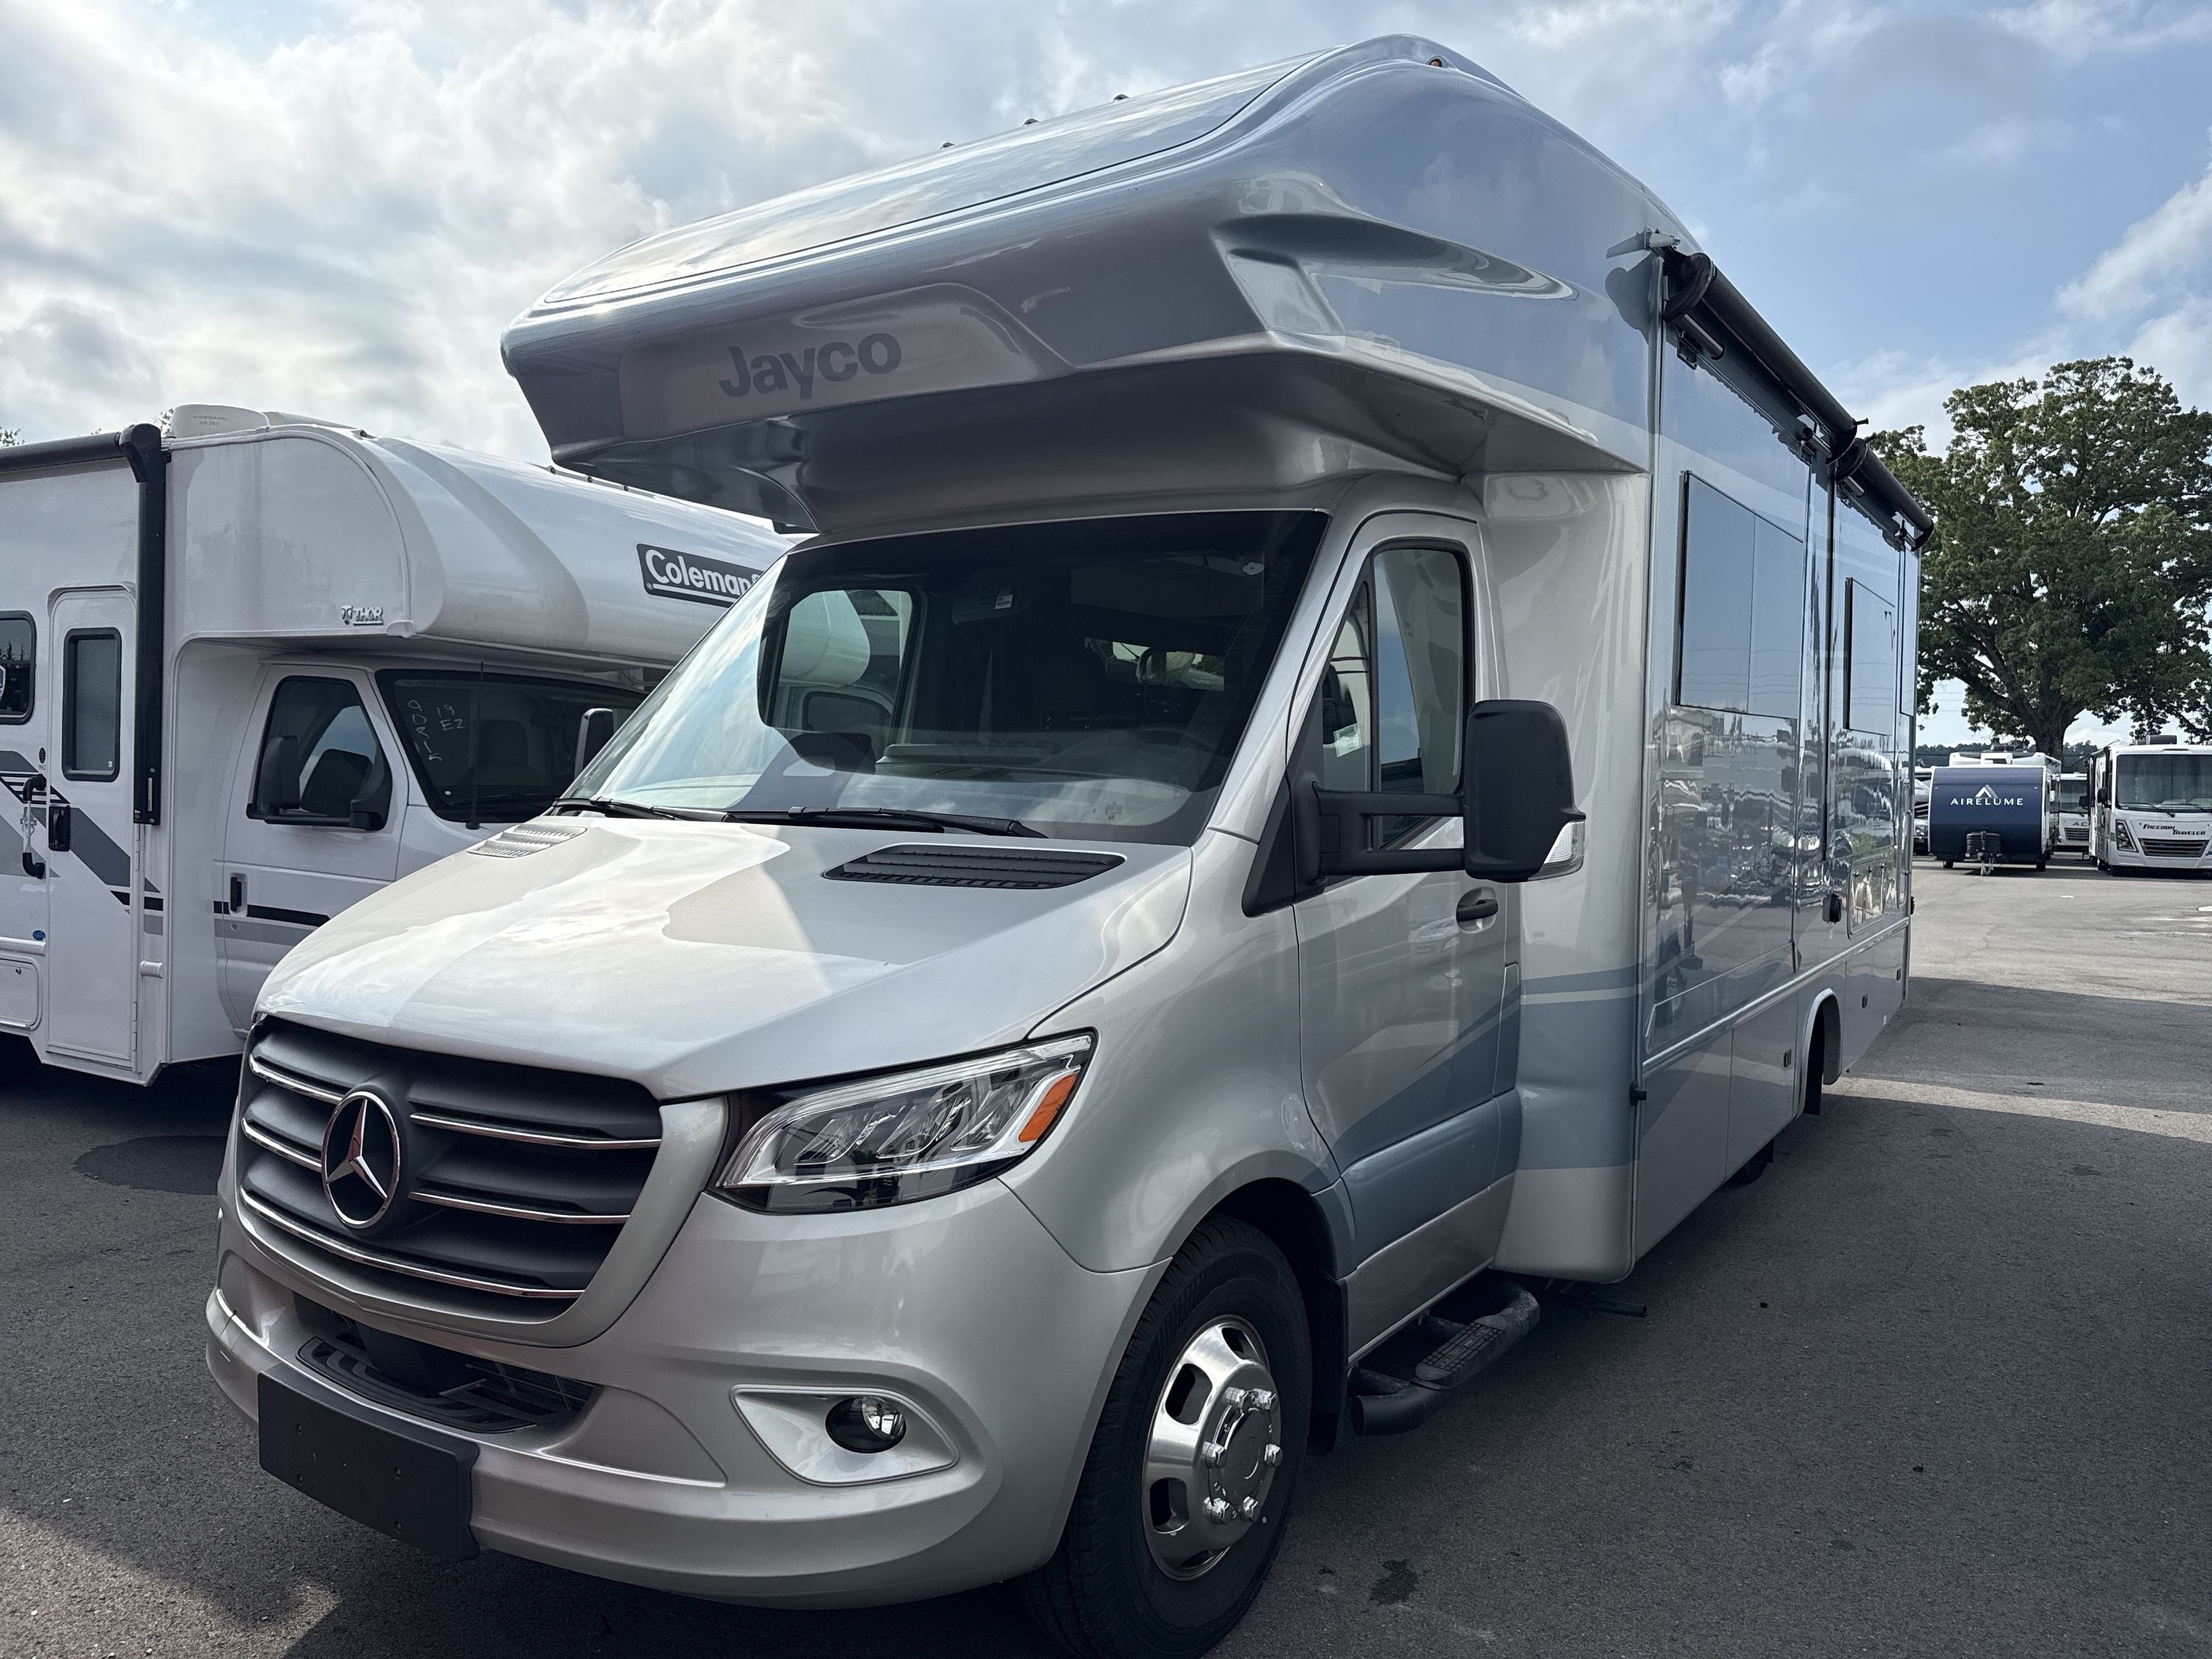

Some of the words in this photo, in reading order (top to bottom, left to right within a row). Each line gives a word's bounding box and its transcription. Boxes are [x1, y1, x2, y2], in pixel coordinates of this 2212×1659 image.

[718, 333, 902, 400] Jayco
[645, 549, 752, 597] Coleman
[354, 606, 383, 622] THOR
[436, 703, 455, 719] 19
